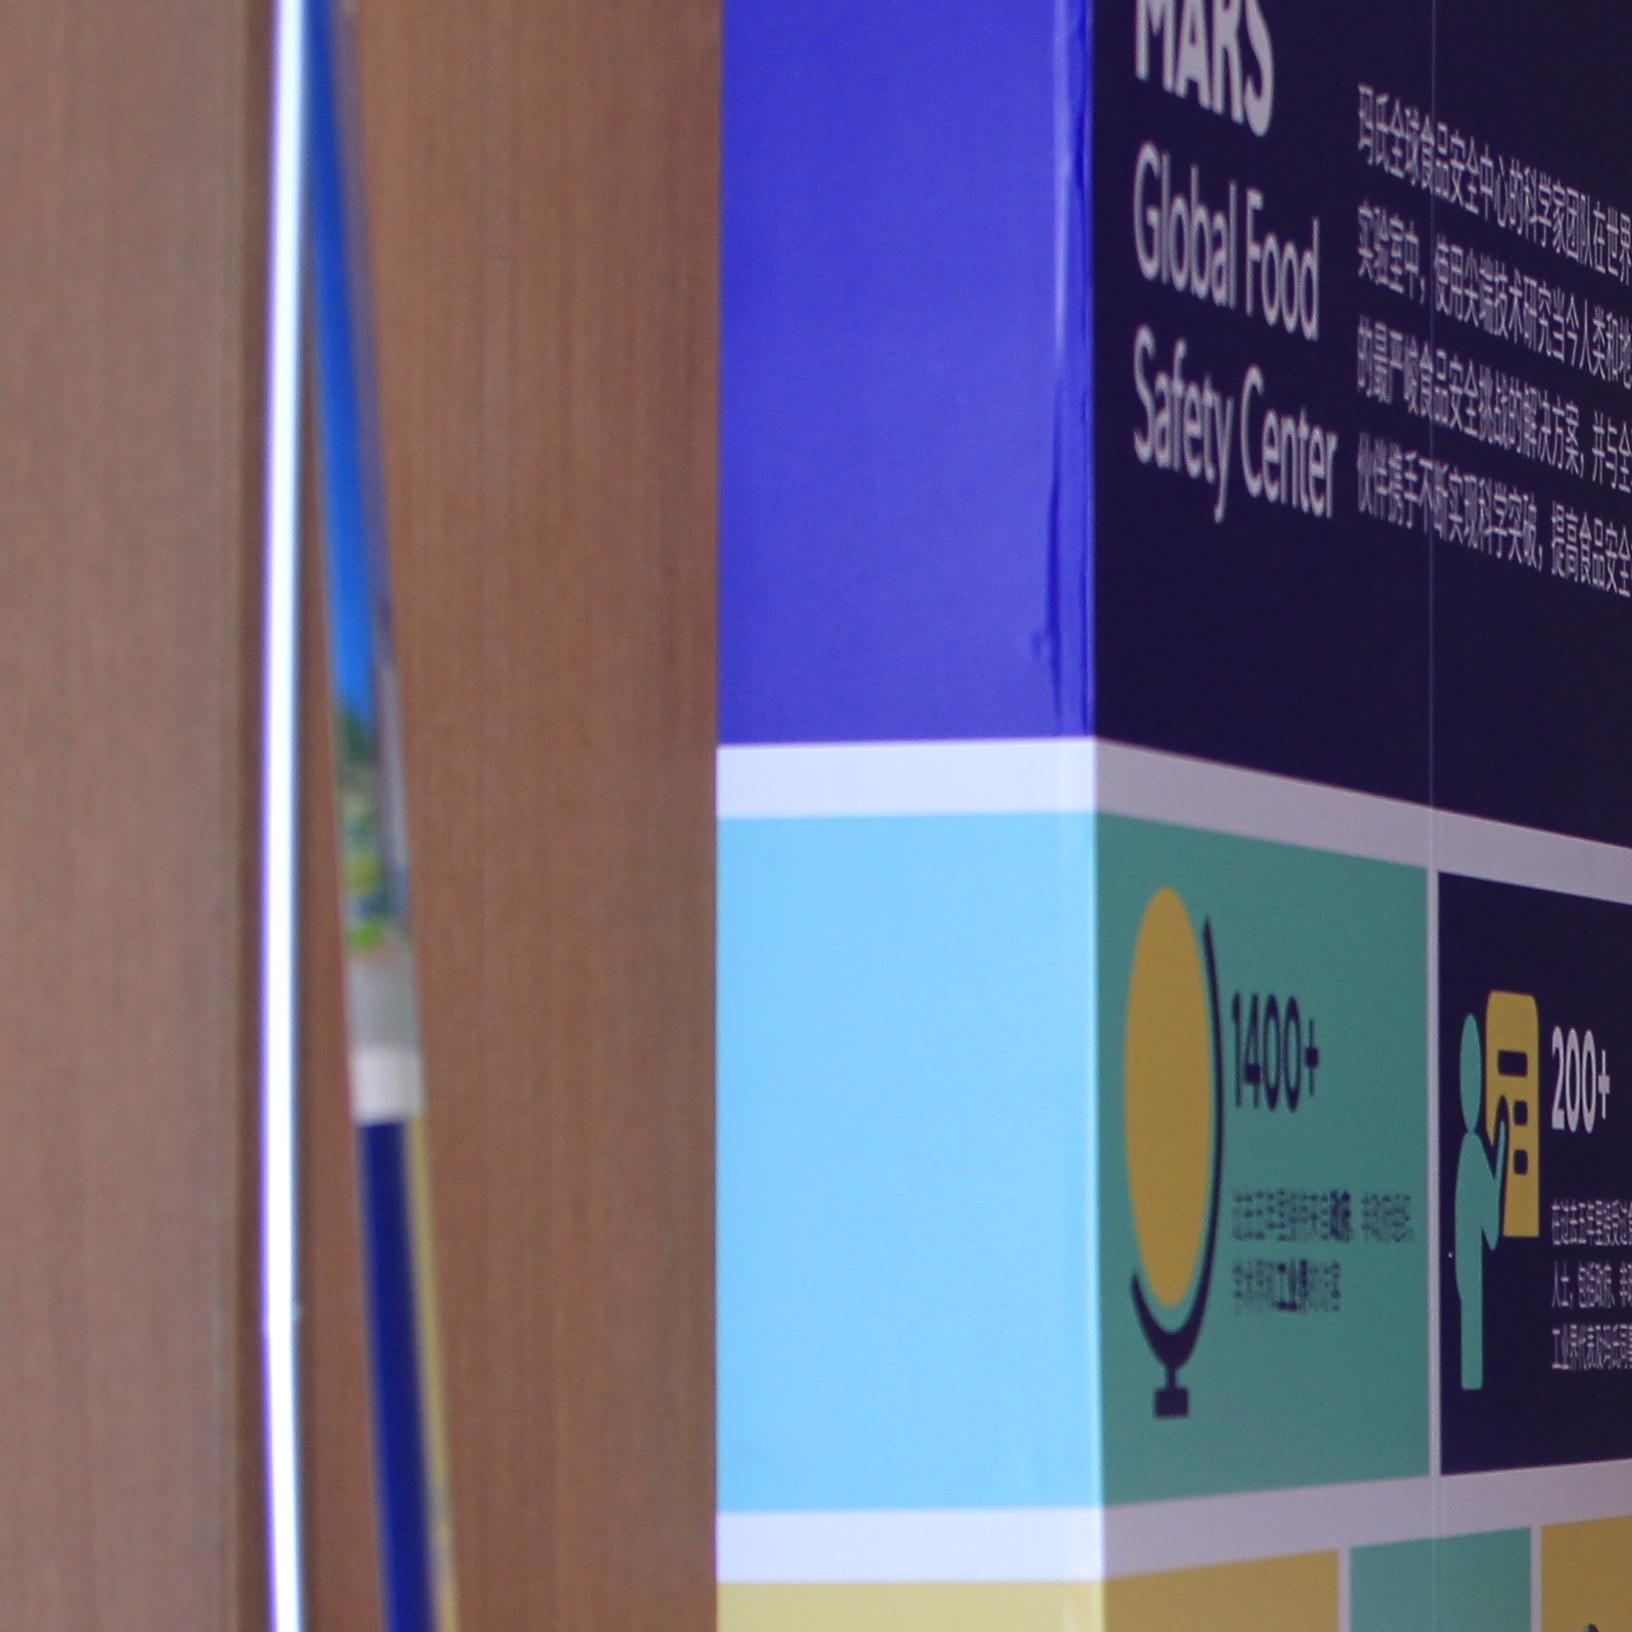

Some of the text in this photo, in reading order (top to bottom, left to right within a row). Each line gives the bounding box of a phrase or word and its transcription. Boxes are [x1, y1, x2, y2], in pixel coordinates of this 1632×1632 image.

[1134, 140, 1320, 342] Global Food
[1134, 325, 1338, 524] Safety Center
[1231, 991, 1318, 1113] 1400+
[1551, 1026, 1610, 1134] 200+
